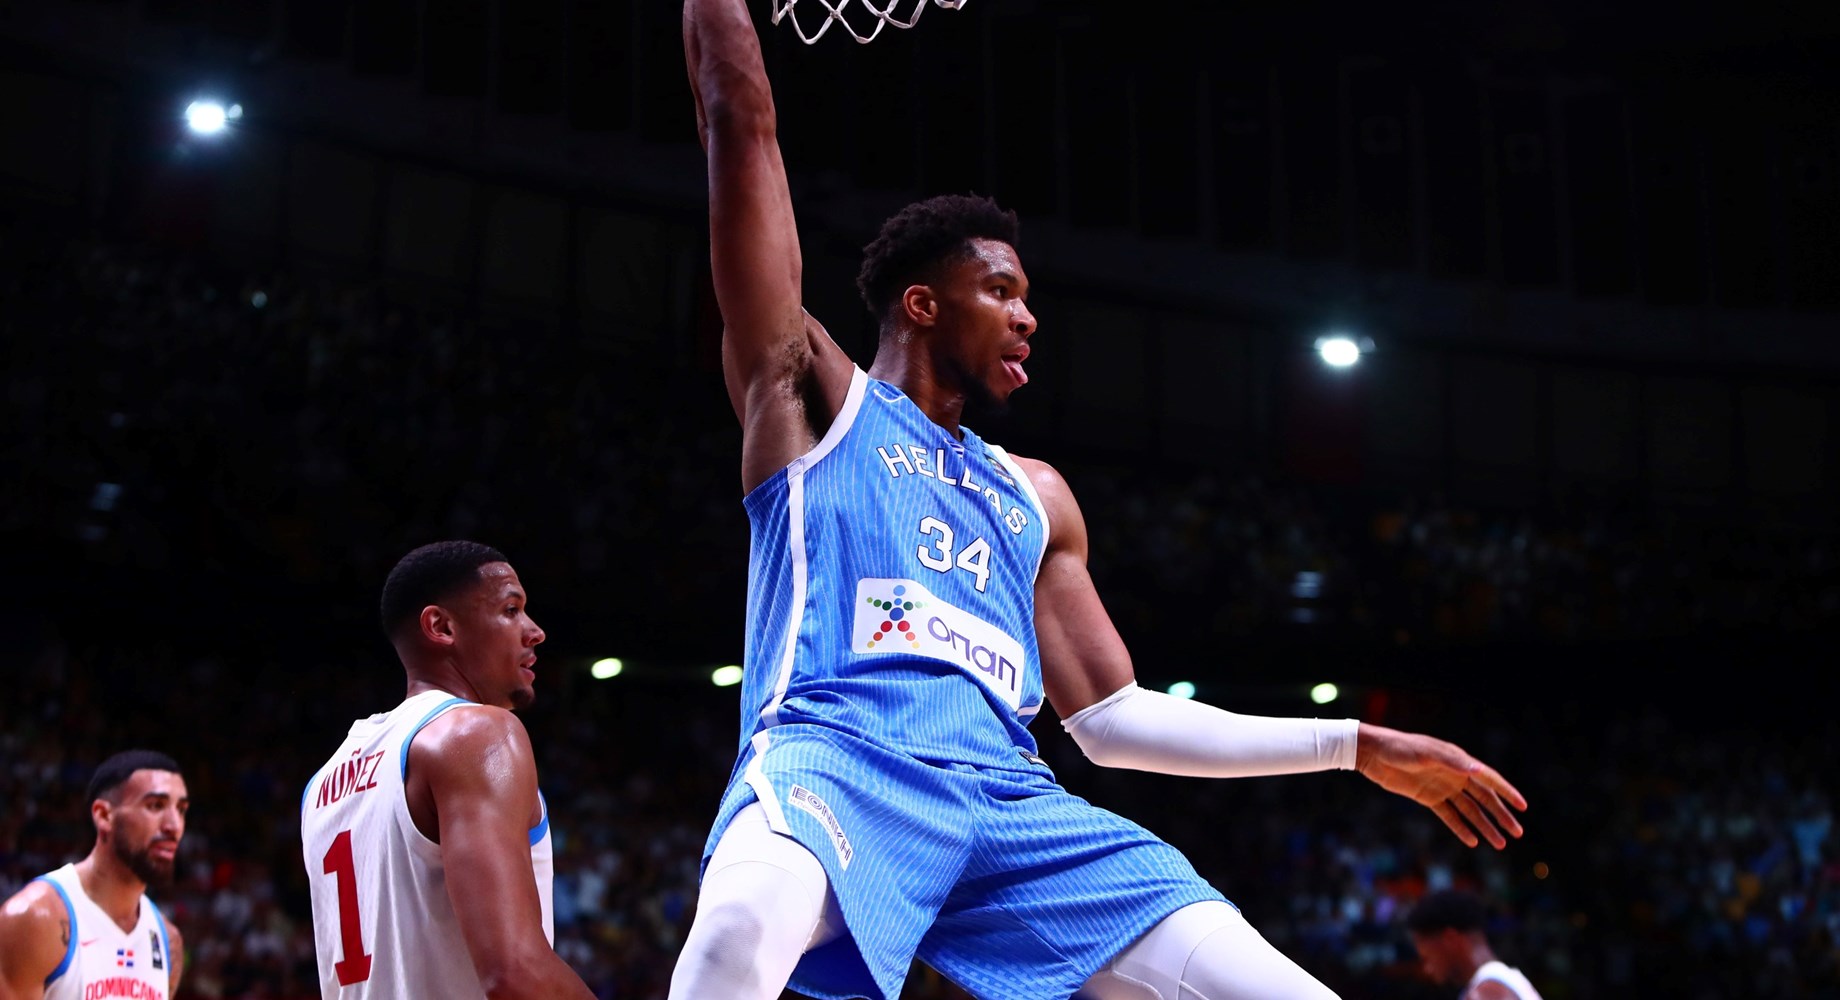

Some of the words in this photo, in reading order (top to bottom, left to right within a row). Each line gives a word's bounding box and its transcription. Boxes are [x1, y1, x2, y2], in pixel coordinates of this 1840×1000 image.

[876, 443, 1029, 536] HELLAS
[917, 515, 992, 594] 34
[315, 747, 386, 809] NUÑEZ
[322, 829, 373, 988] 1
